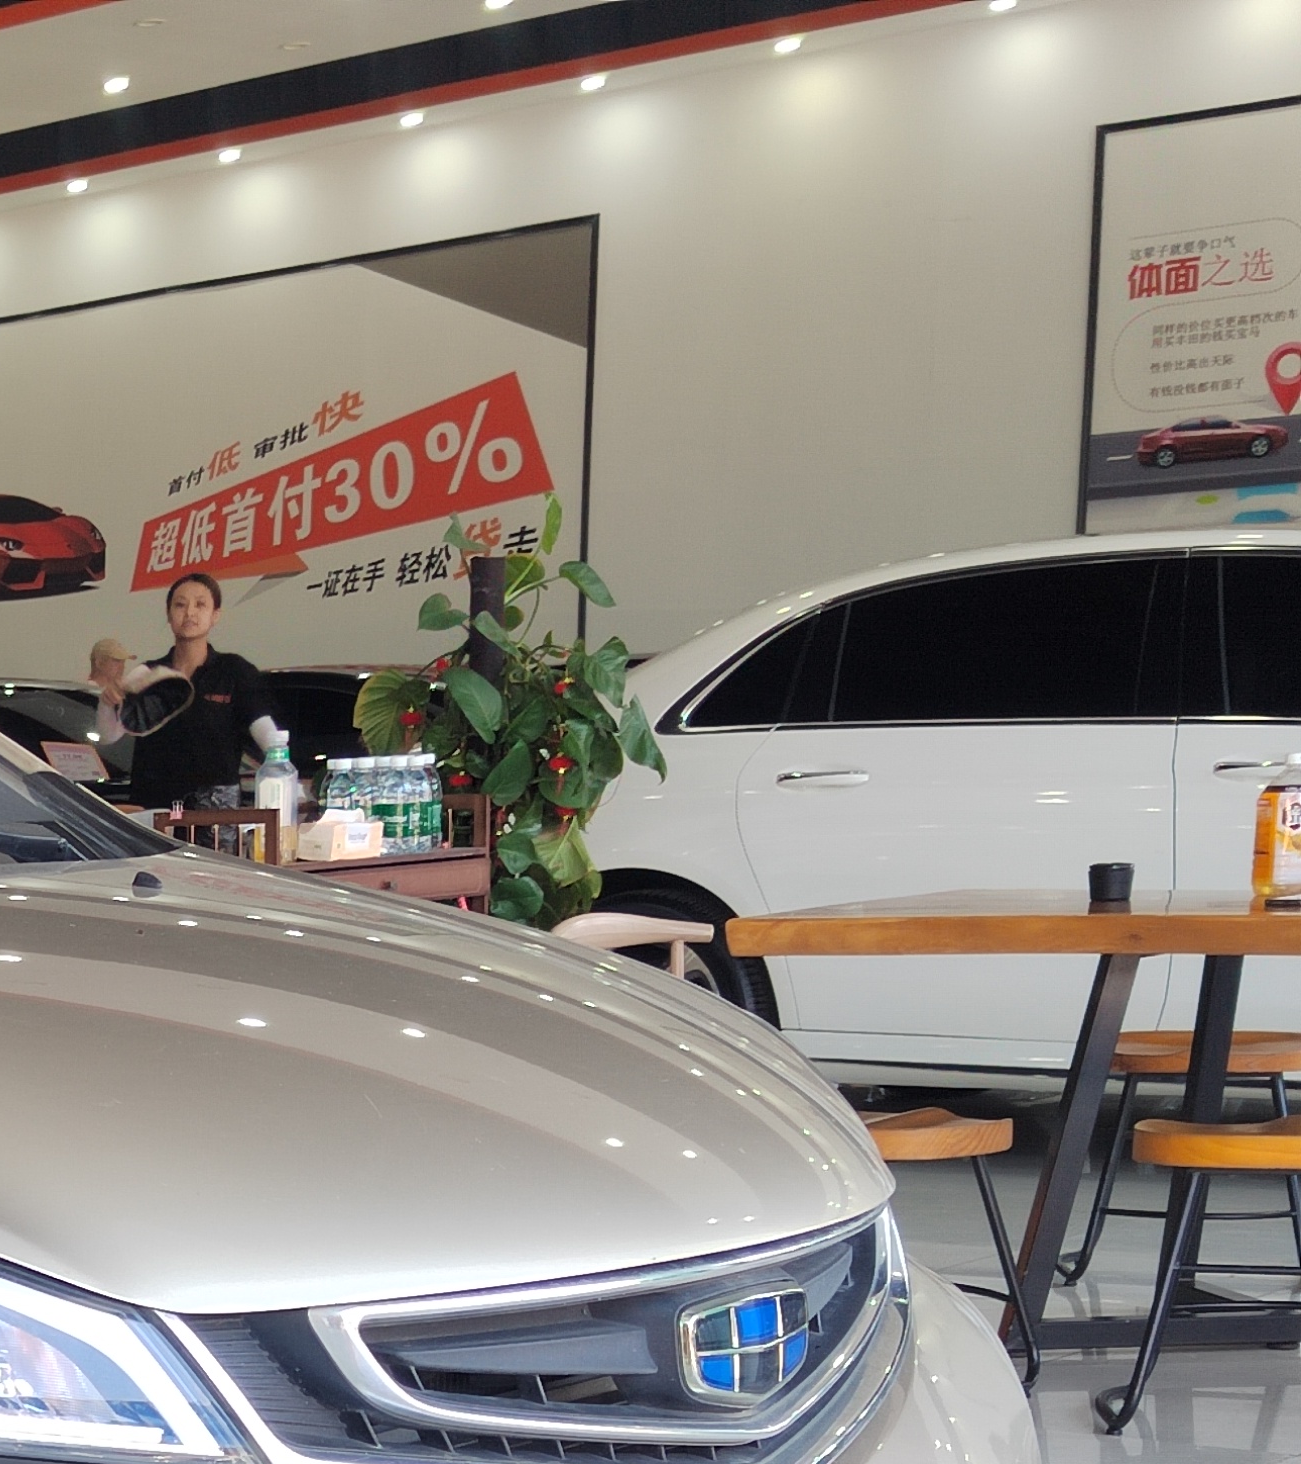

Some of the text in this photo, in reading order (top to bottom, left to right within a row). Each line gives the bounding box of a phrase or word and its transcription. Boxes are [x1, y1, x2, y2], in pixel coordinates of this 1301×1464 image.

[1127, 247, 1275, 301] 体面之选
[167, 390, 365, 497] 首付低 审批快
[145, 398, 524, 573] 超低首付30%
[306, 557, 386, 599] 一证在手
